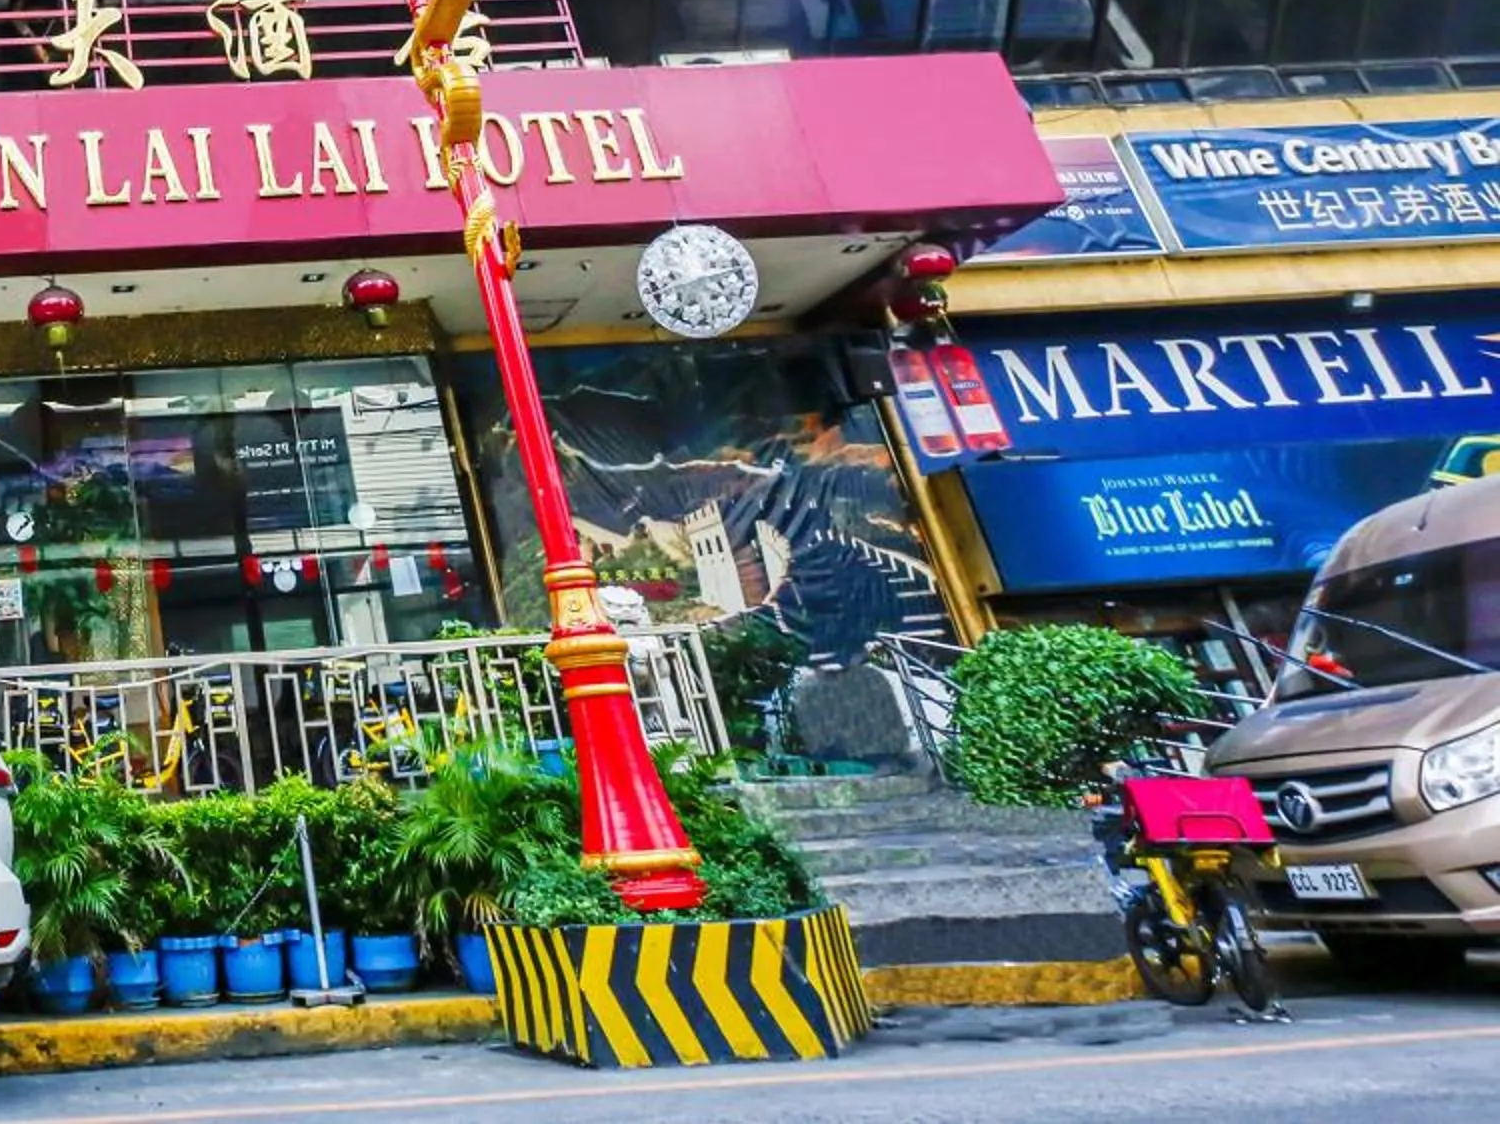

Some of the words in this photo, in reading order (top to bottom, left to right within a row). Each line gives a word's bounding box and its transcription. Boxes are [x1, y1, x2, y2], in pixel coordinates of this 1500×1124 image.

[79, 126, 222, 206] LAI
[246, 120, 389, 199] LAI
[1151, 141, 1281, 180] Wine
[1282, 137, 1463, 177] Century
[990, 324, 1493, 423] MARTELL
[1101, 476, 1162, 492] JOHNNIE
[1161, 472, 1219, 487] WALKER
[1080, 492, 1170, 541] Blue
[1160, 488, 1265, 537] Label
